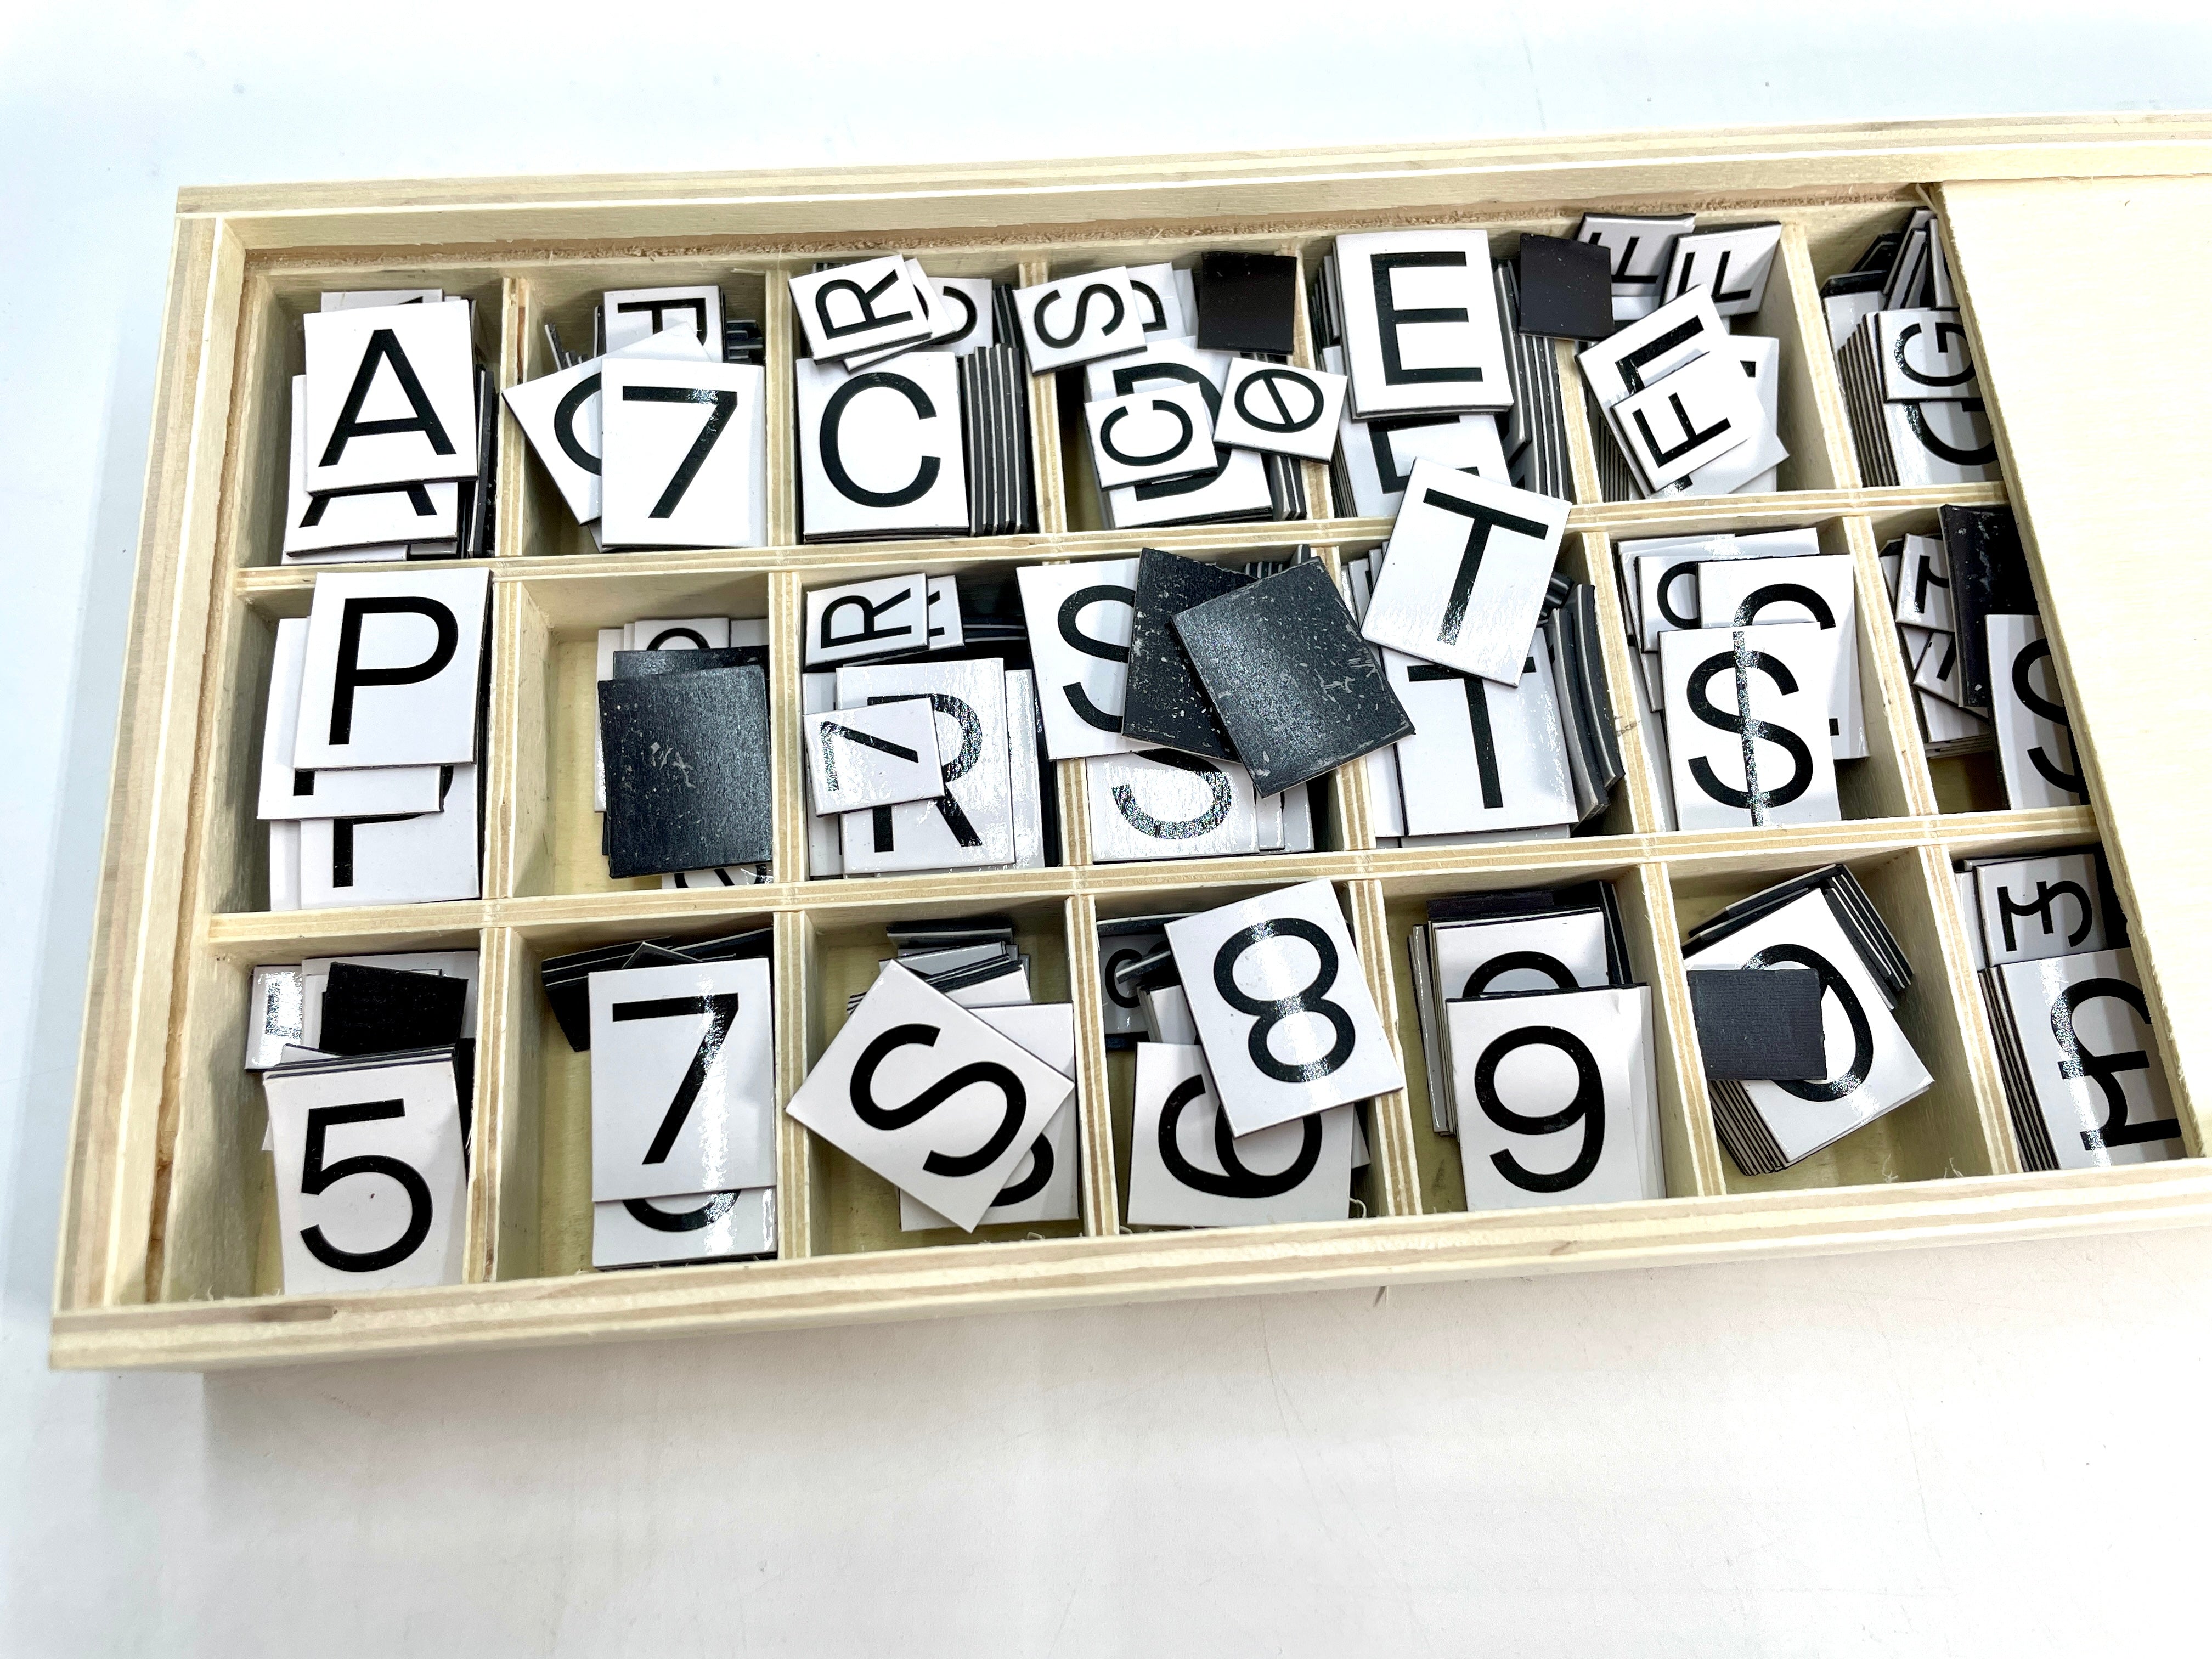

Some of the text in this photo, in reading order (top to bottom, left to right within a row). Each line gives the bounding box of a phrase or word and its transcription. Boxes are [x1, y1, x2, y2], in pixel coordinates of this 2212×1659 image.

[815, 269, 913, 340] R
[1034, 283, 1125, 349] S
[1370, 251, 1483, 386] E
[318, 329, 456, 467] A
[623, 386, 737, 519] 7
[820, 371, 941, 508] C
[1100, 399, 1193, 467] C
[1633, 393, 1732, 467] F
[821, 588, 912, 648] R
[1423, 488, 1548, 645] T
[329, 596, 458, 745] P
[1407, 657, 1536, 809] T
[1687, 631, 1813, 826] $
[1214, 917, 1355, 1083] 8
[613, 993, 738, 1165] 7
[850, 1023, 1026, 1177] S
[1474, 1025, 1605, 1193] 9
[301, 1098, 433, 1272] 5
